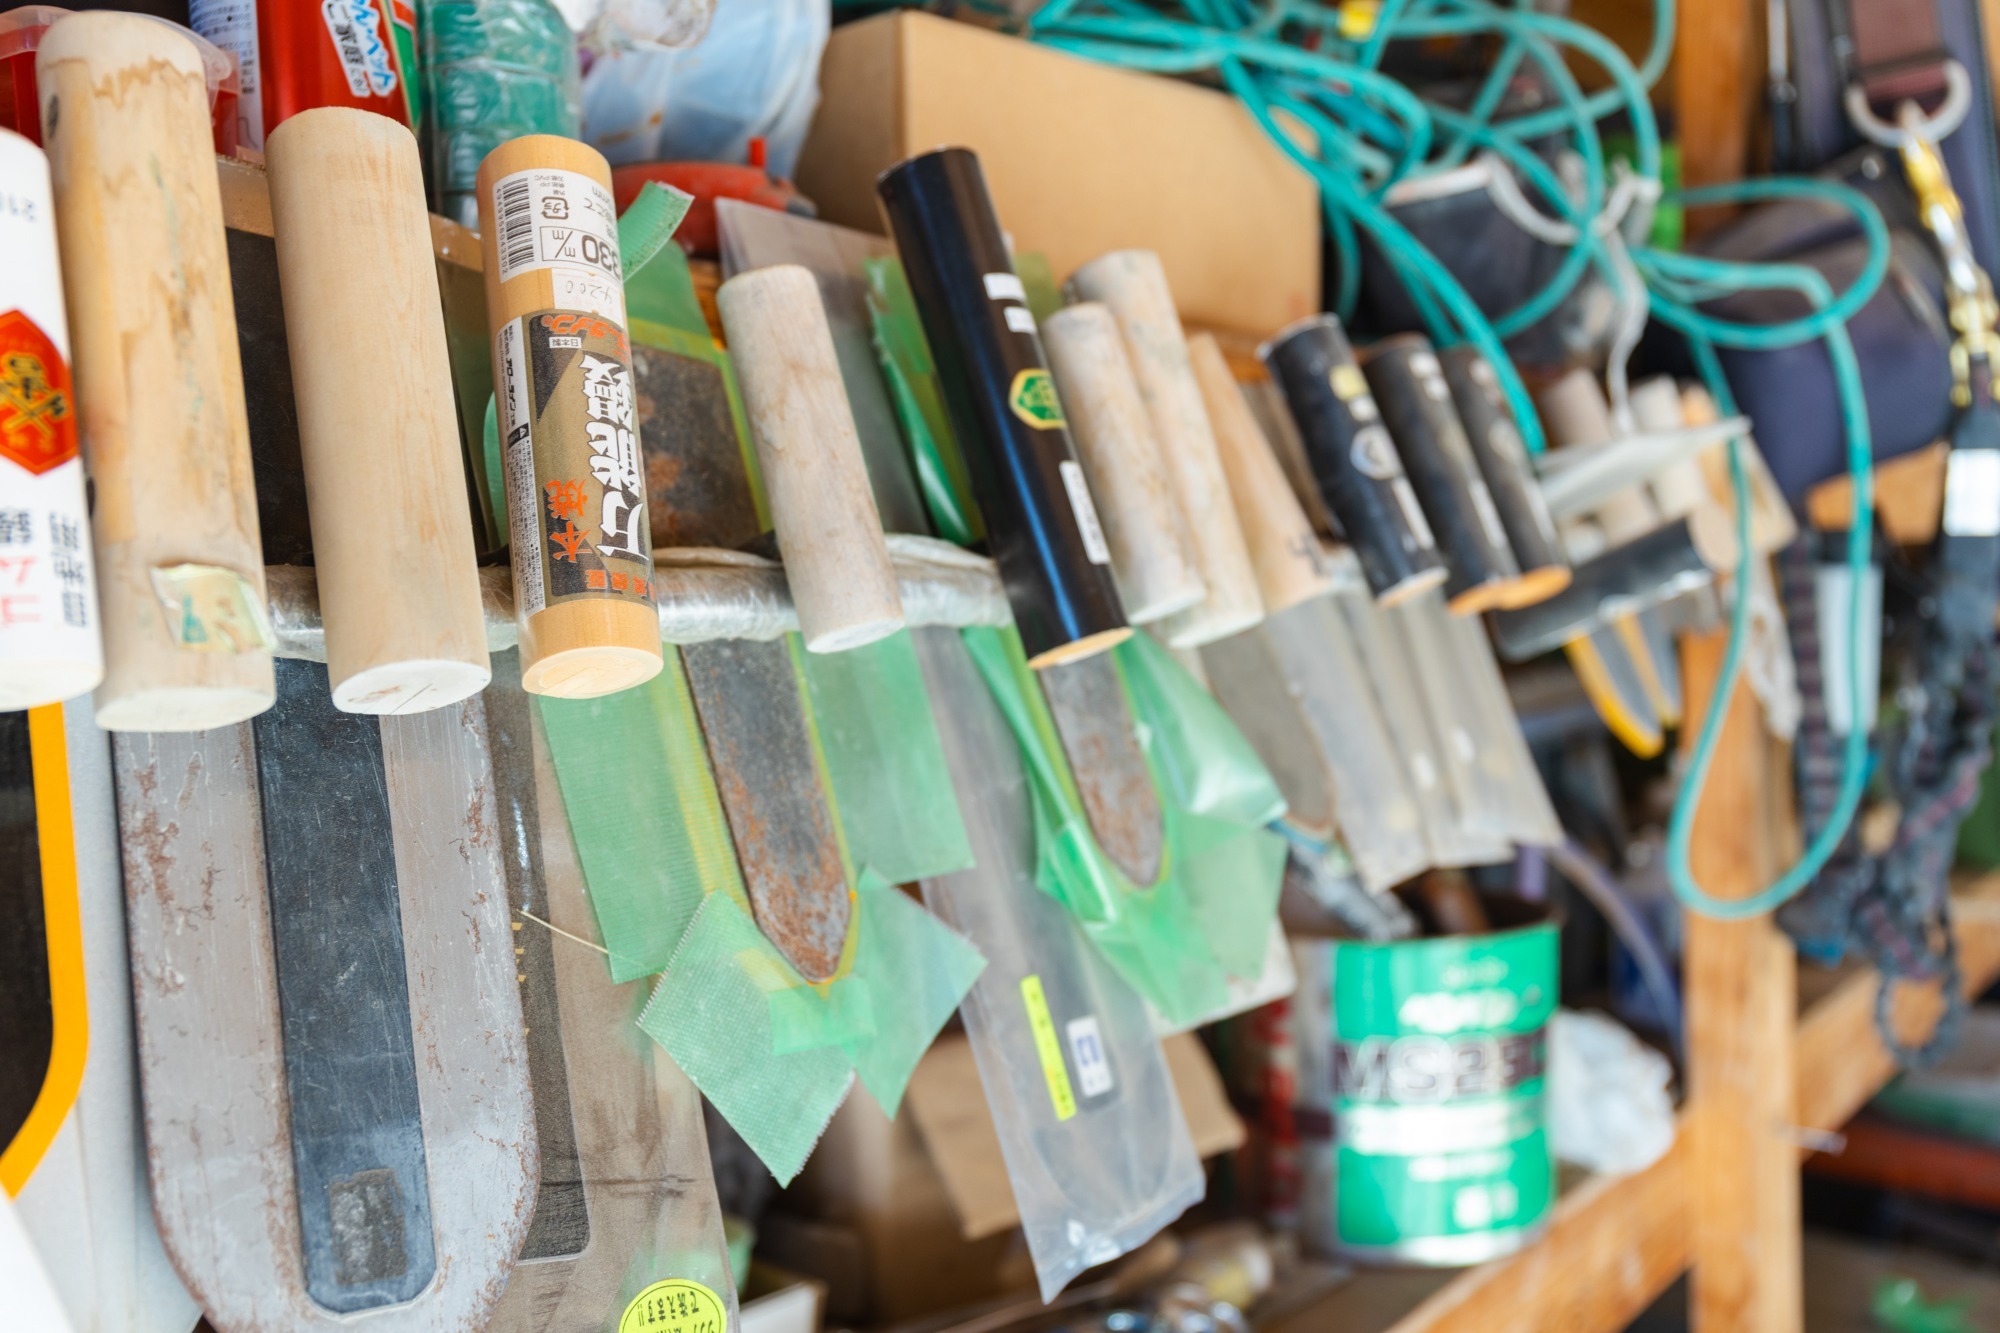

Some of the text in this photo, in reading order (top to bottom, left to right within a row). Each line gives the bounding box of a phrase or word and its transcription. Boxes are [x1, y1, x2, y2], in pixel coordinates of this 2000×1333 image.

[496, 188, 509, 275] 4949956043302
[582, 234, 622, 280] 330
[566, 280, 613, 304] 4200
[552, 338, 579, 348] 日本製
[545, 478, 594, 564] 本焼
